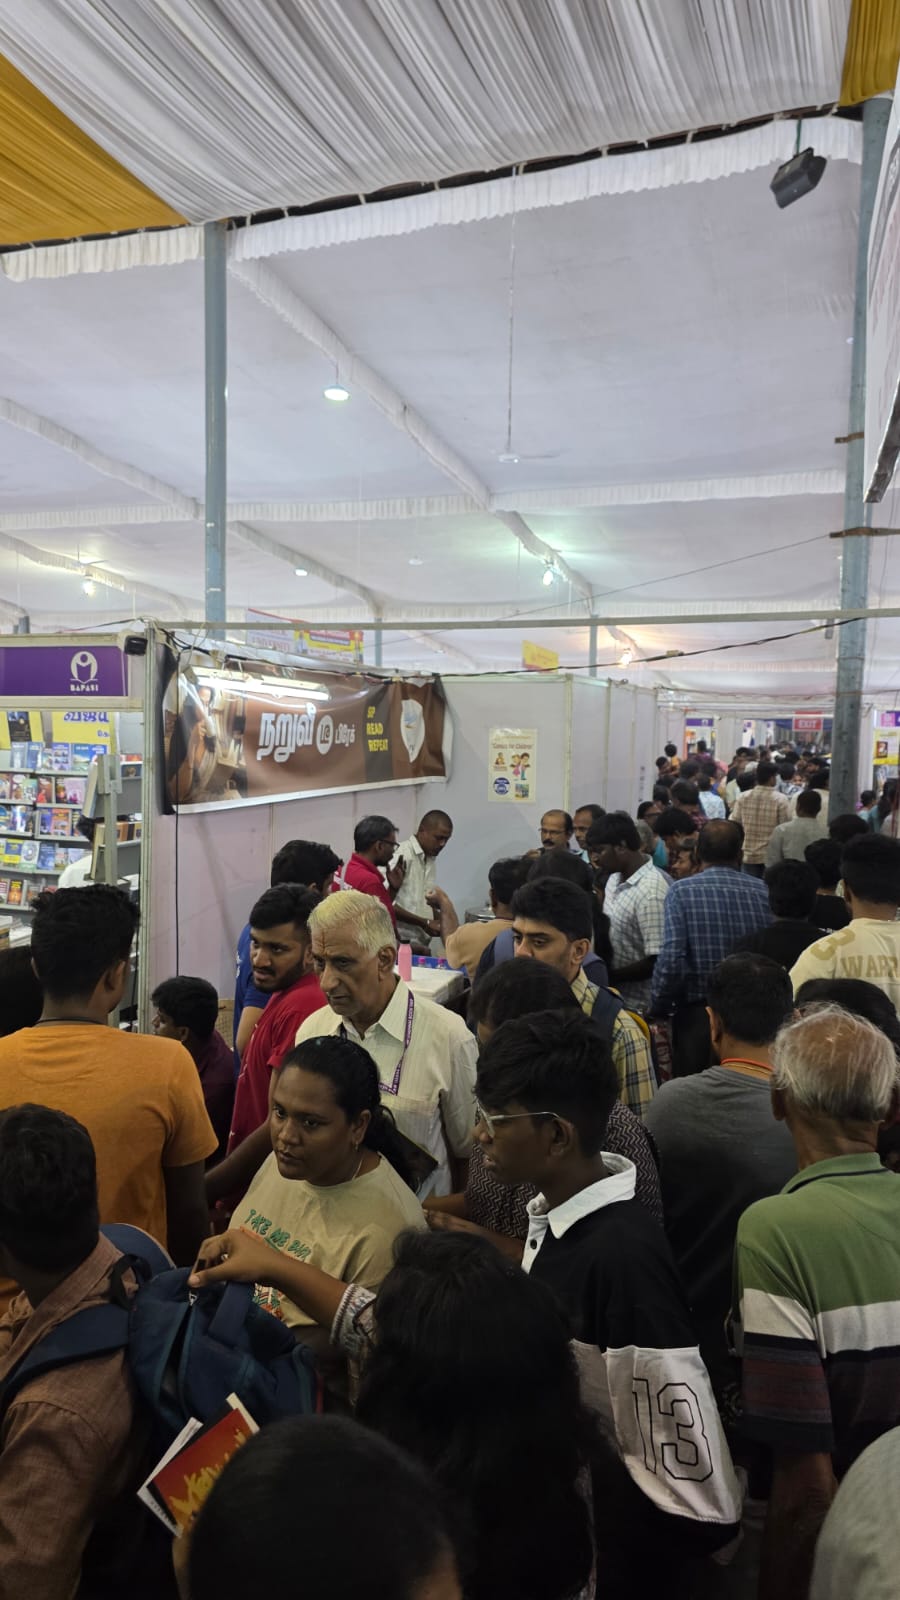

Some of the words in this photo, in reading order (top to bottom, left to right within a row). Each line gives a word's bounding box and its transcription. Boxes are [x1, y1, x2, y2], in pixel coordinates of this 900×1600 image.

[70, 684, 98, 692] BAPASI
[366, 722, 384, 736] READ
[799, 719, 817, 729] EXIT
[368, 739, 389, 752] REPEAT
[632, 1378, 713, 1482] 13
